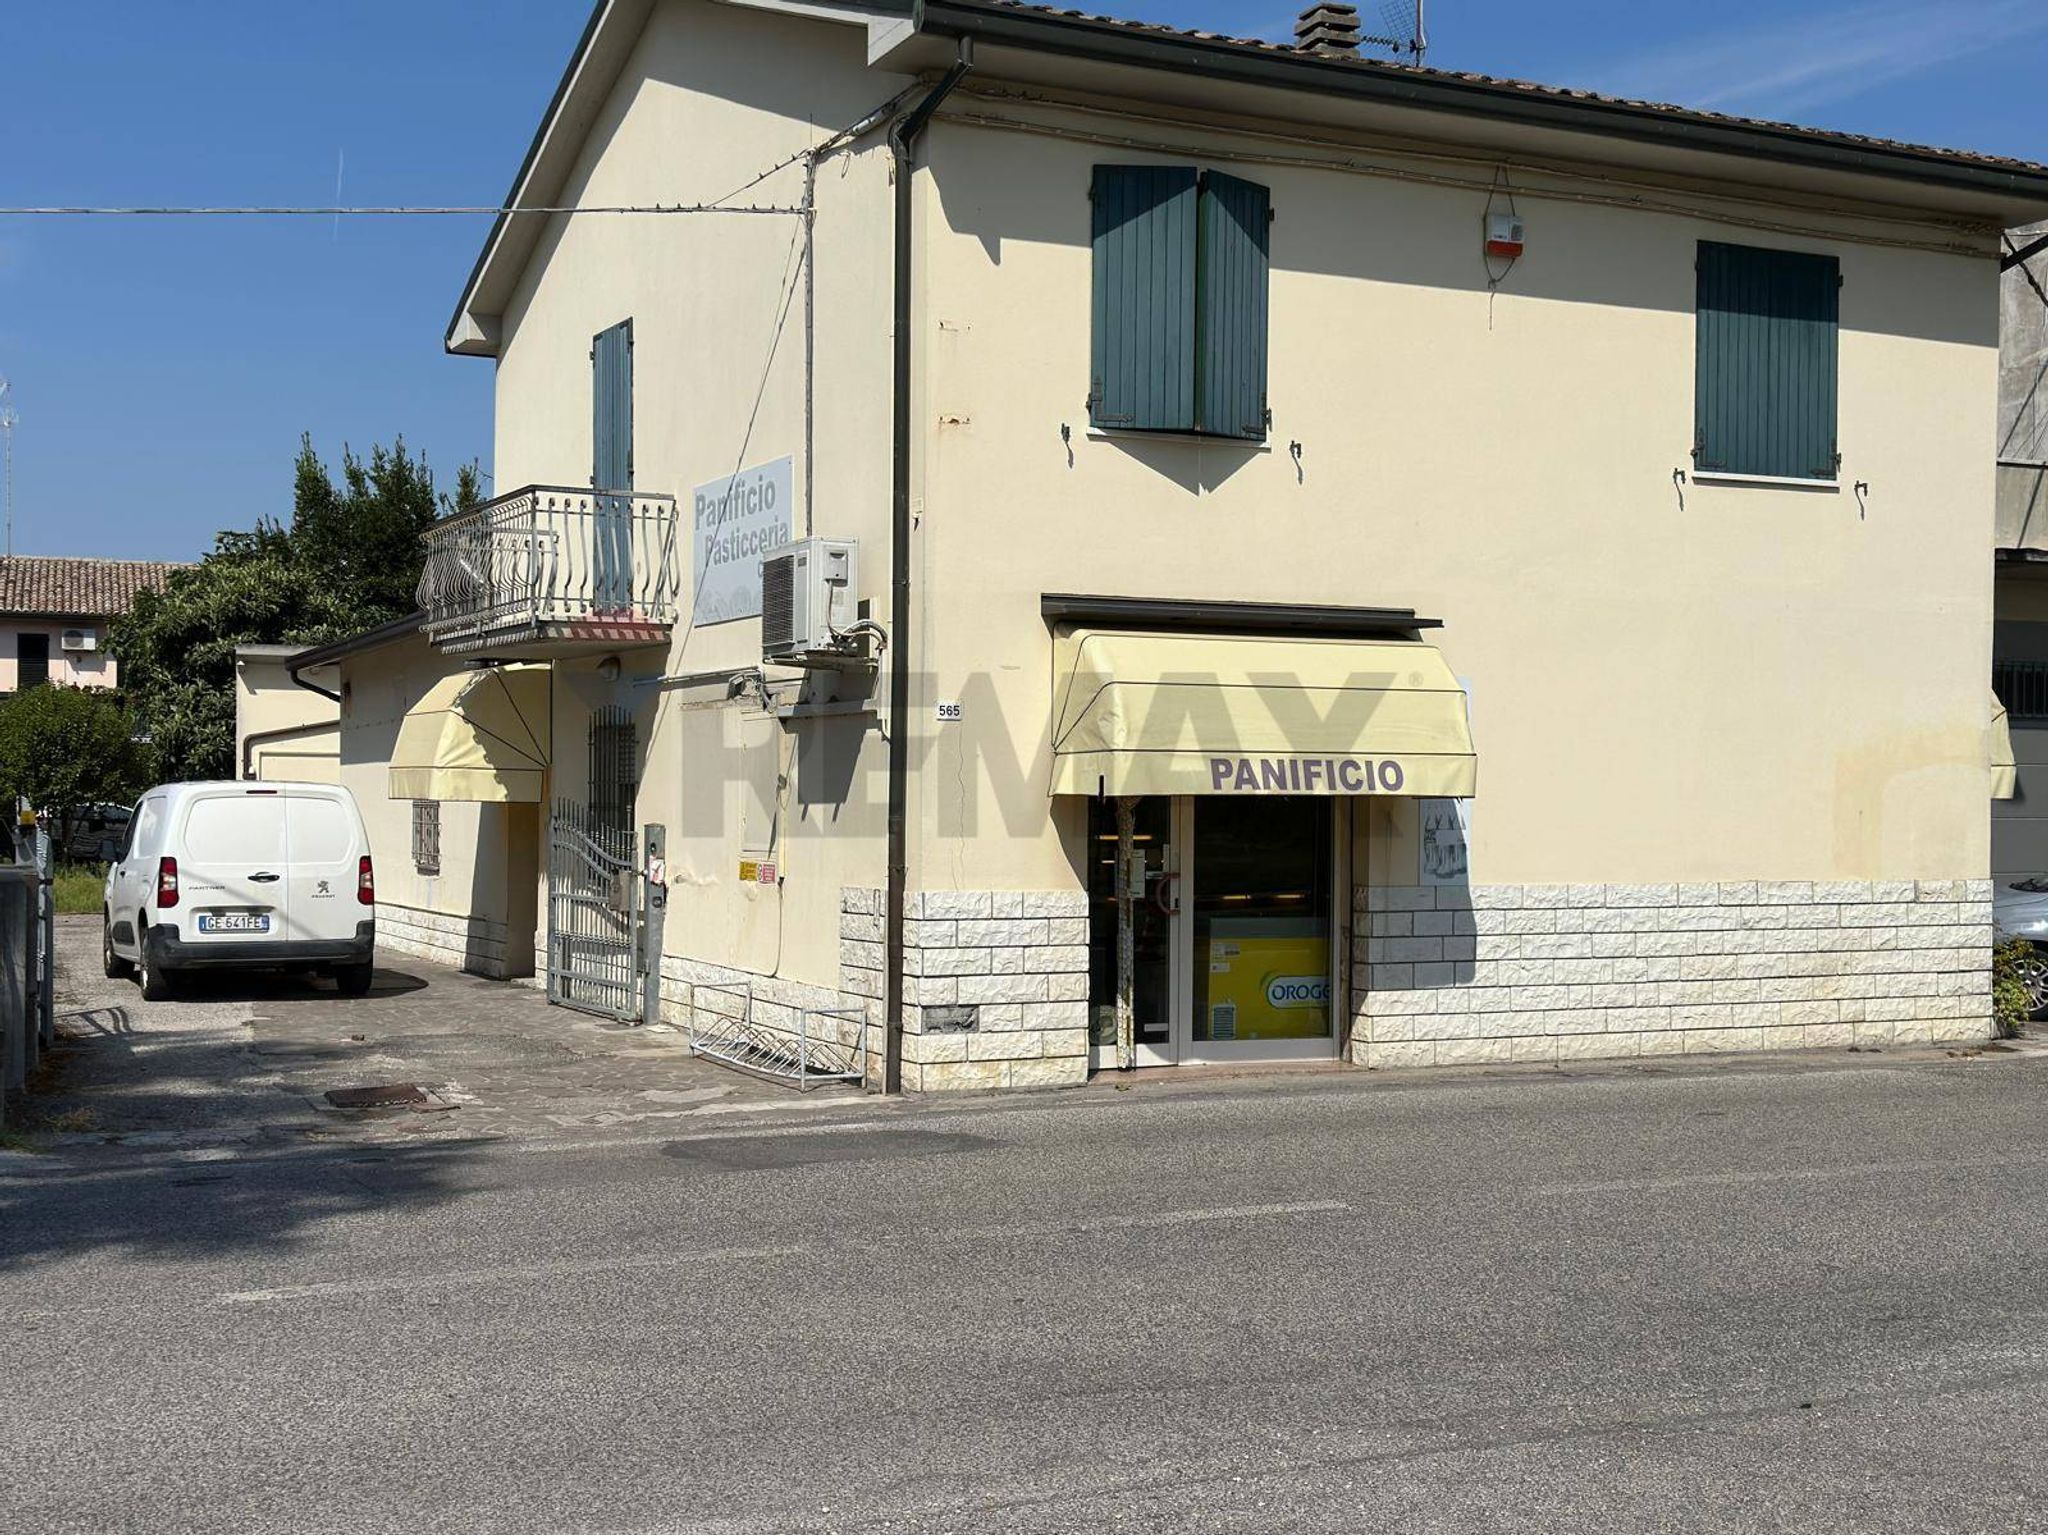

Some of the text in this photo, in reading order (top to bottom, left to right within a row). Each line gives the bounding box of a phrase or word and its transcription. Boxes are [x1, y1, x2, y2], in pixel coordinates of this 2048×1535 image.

[695, 474, 776, 531] Panificio
[705, 515, 788, 566] Pasticceria
[939, 704, 960, 717] 565
[1210, 758, 1405, 792] PANIFICIO
